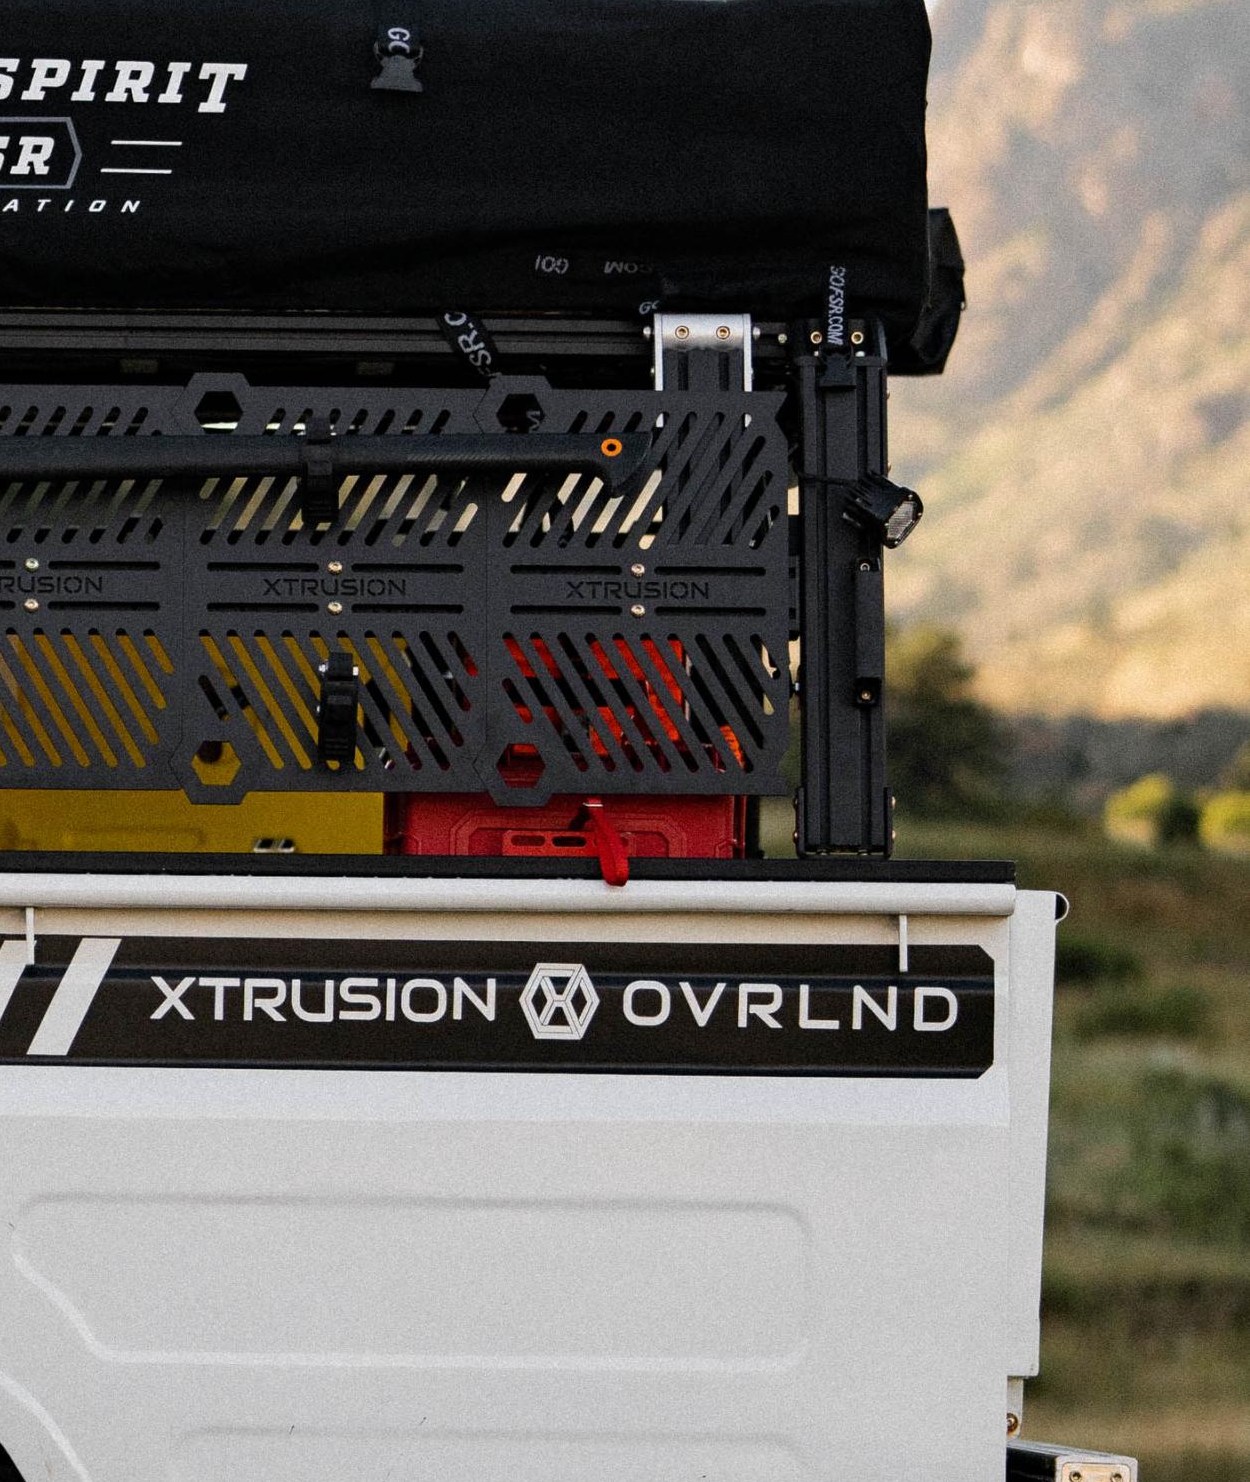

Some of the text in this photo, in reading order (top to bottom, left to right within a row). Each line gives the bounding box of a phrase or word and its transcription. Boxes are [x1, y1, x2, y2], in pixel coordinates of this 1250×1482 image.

[262, 578, 407, 597] XTRUSION
[566, 581, 709, 599] XTRUSION
[149, 976, 958, 1032] XTRUSION OVRLND
